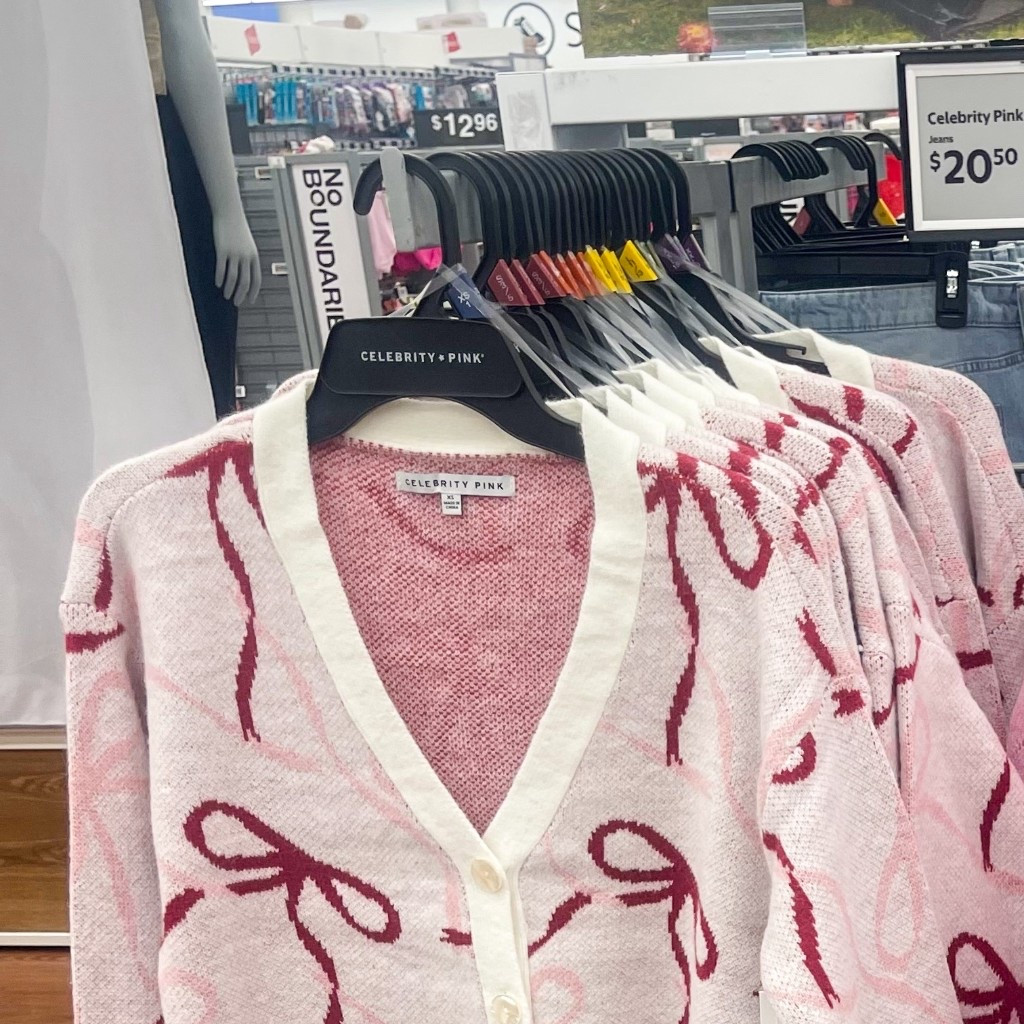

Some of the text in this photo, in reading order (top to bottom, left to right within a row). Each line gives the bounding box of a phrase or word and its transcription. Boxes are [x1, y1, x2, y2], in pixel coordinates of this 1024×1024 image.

[927, 108, 1024, 126] Celebrity Pink
[928, 135, 954, 144] Jeans
[323, 168, 343, 207] NO
[302, 169, 345, 331] BOUNDARIE
[360, 351, 485, 364] CELEBRITY PINK
[405, 478, 504, 491] CELEBRITY PINK
